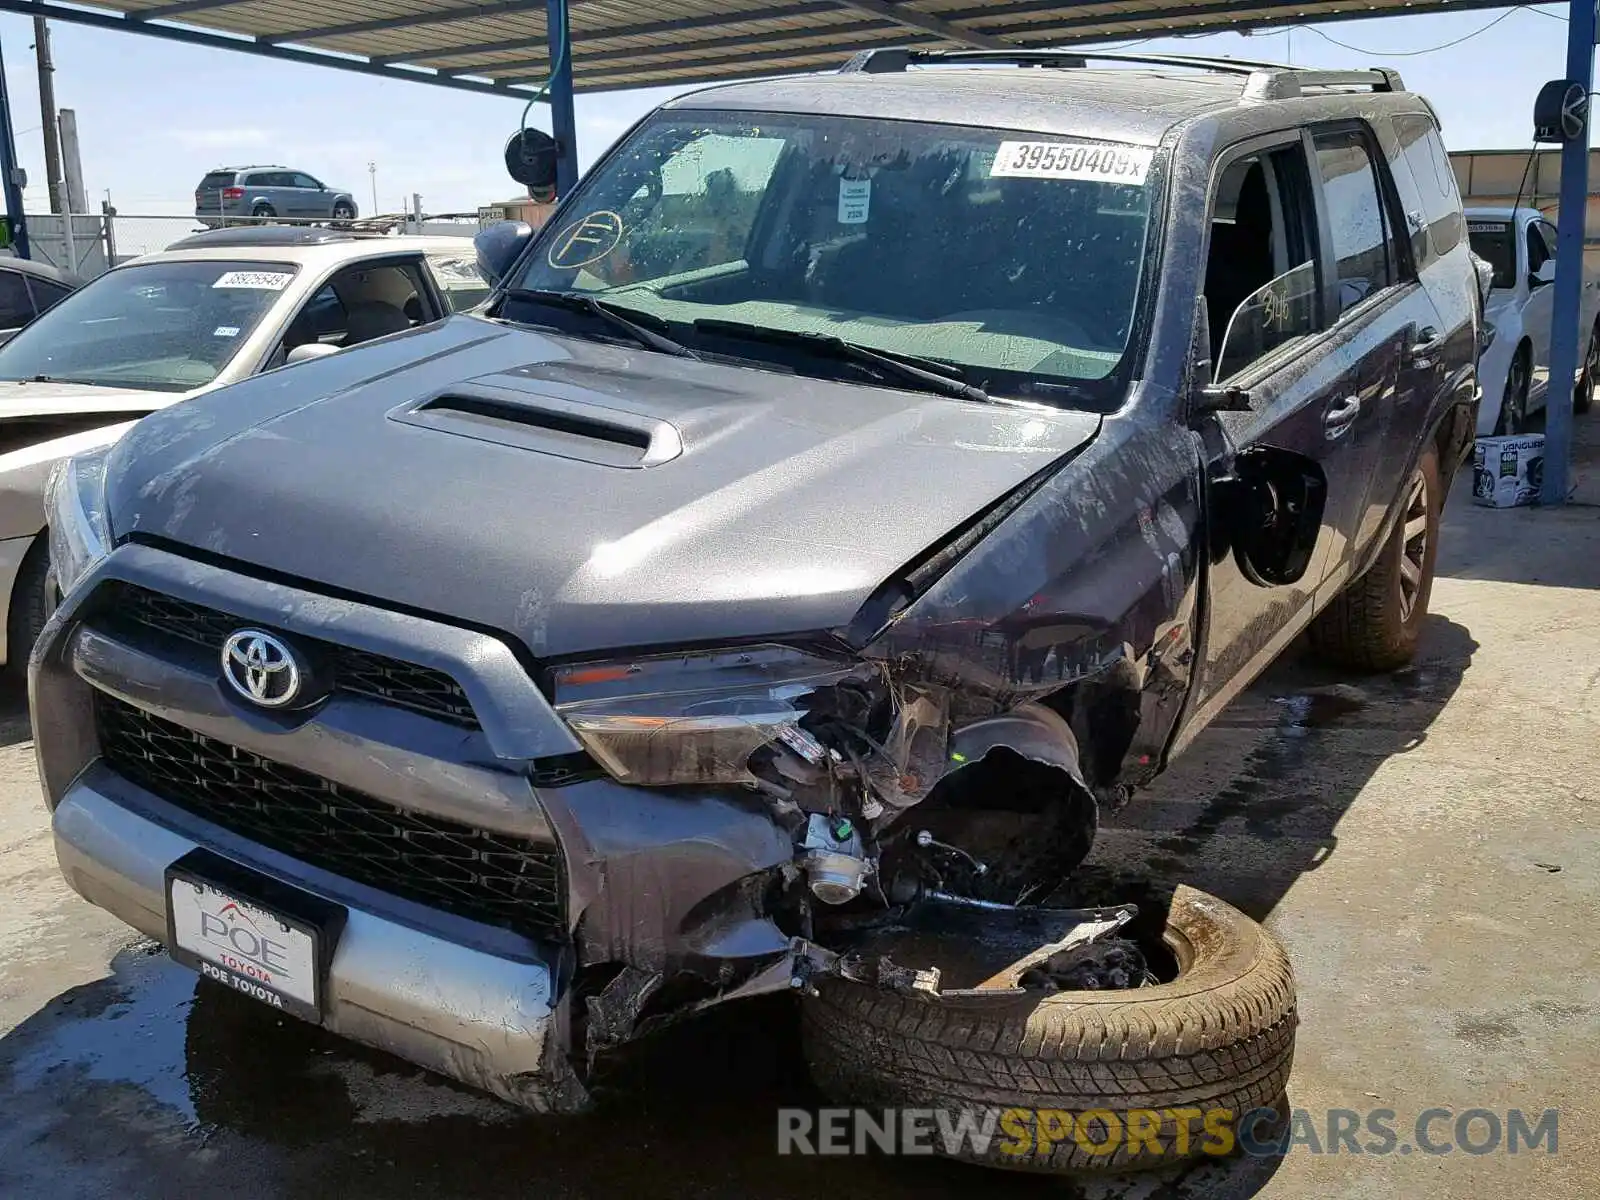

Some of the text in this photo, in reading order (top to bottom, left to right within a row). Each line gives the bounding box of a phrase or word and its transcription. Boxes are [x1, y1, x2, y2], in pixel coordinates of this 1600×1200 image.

[202, 911, 289, 972] POE
[202, 961, 283, 1008] POE TOYOTA
[220, 953, 272, 984] TOYOTA
